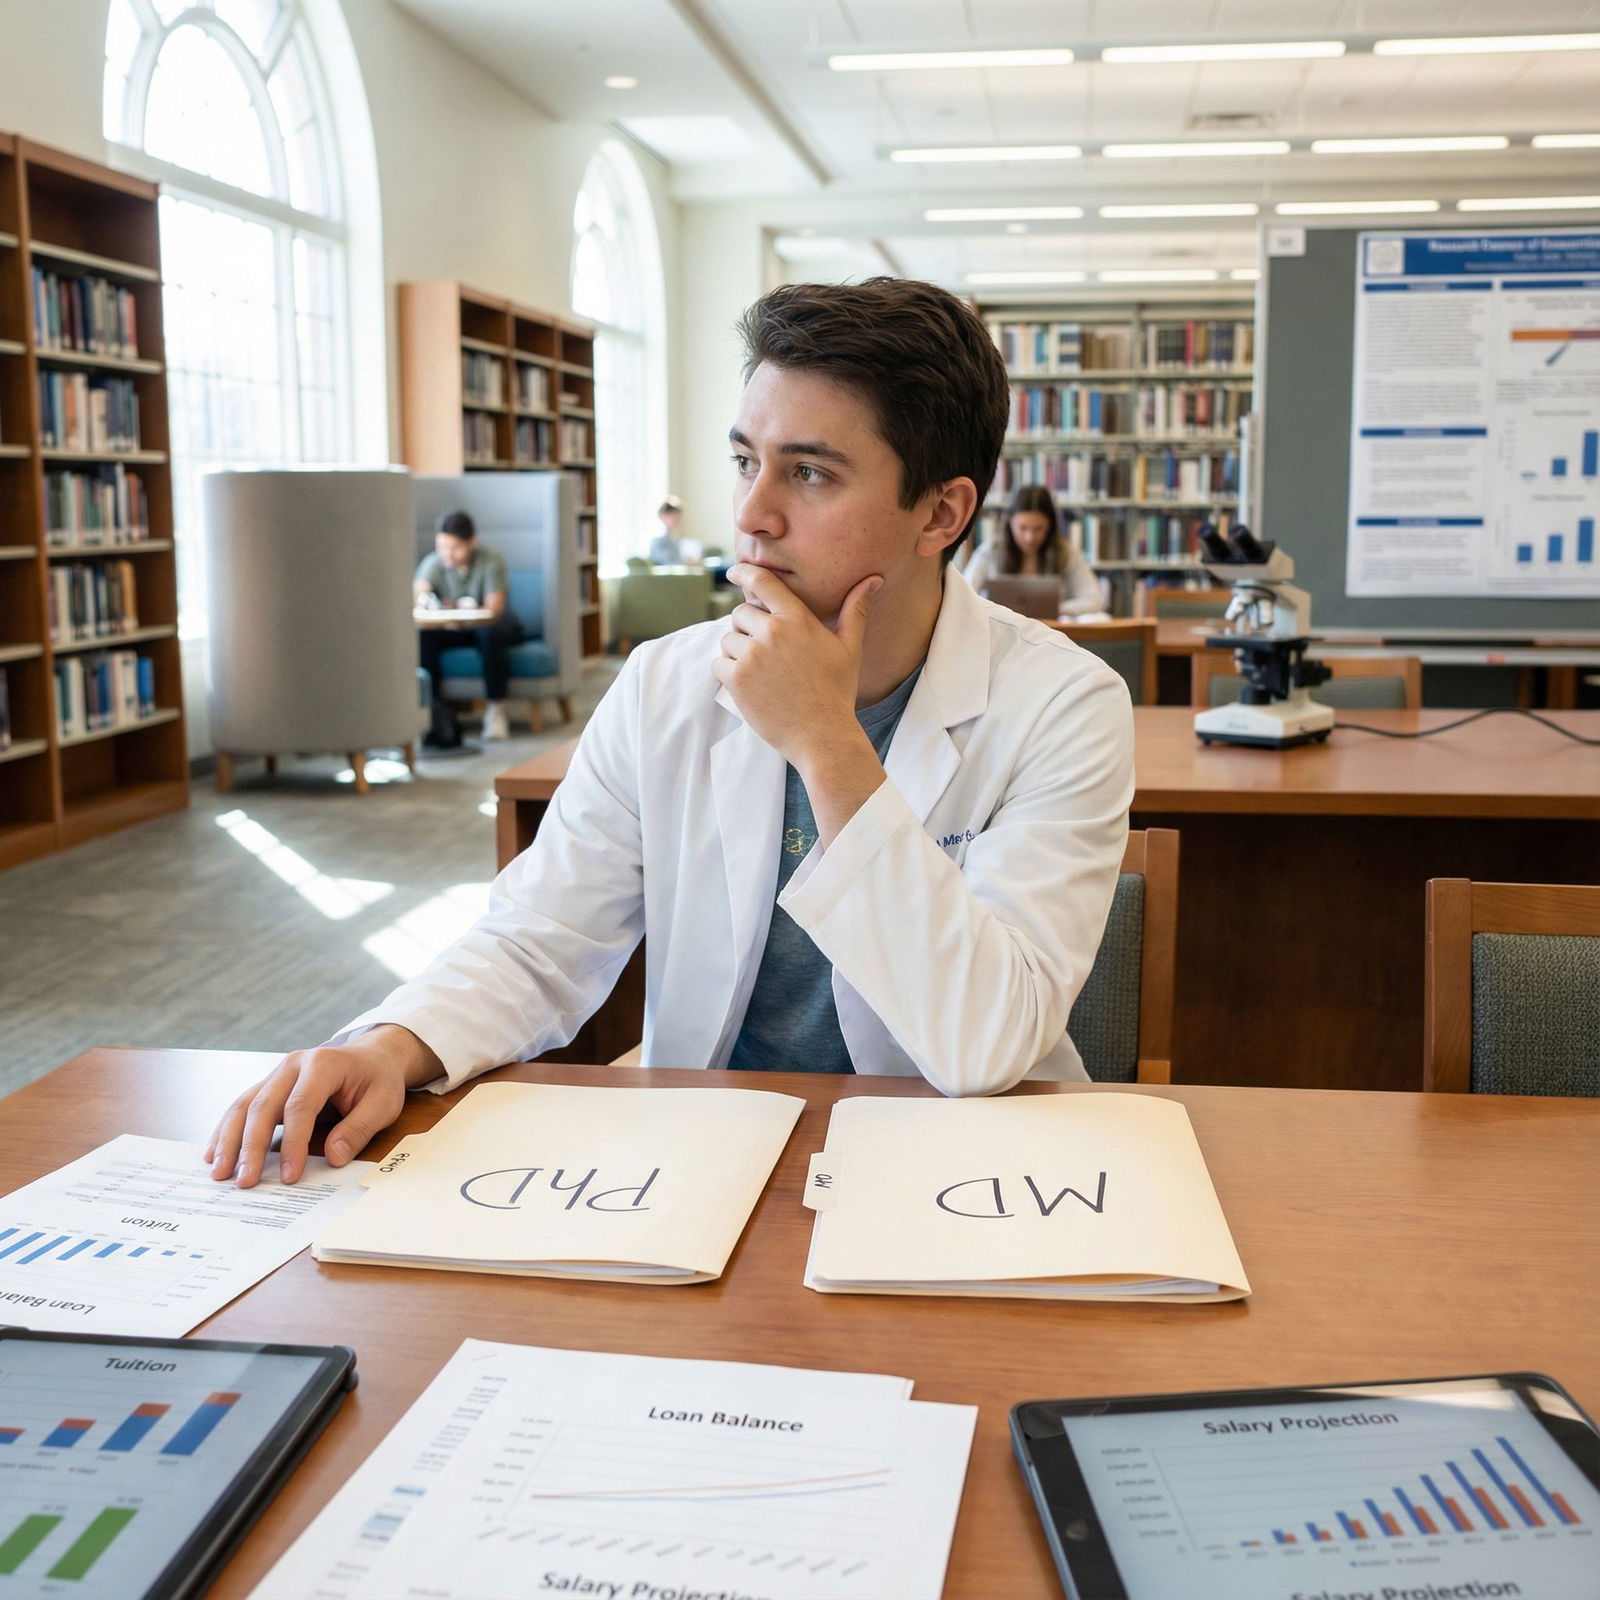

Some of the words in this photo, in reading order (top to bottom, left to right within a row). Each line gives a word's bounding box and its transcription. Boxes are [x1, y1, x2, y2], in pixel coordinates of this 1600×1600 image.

[459, 1167, 661, 1213] PhD
[936, 1171, 1107, 1219] MD
[121, 1216, 181, 1232] Tuition
[48, 1299, 97, 1315] Loan
[105, 1357, 178, 1373] Tuition
[648, 1406, 704, 1423] Loan
[710, 1411, 804, 1433] Balance
[1203, 1420, 1274, 1434] Salary
[1280, 1412, 1400, 1431] Projection
[539, 1571, 623, 1598] Salary
[1381, 1580, 1521, 1600] Projection
